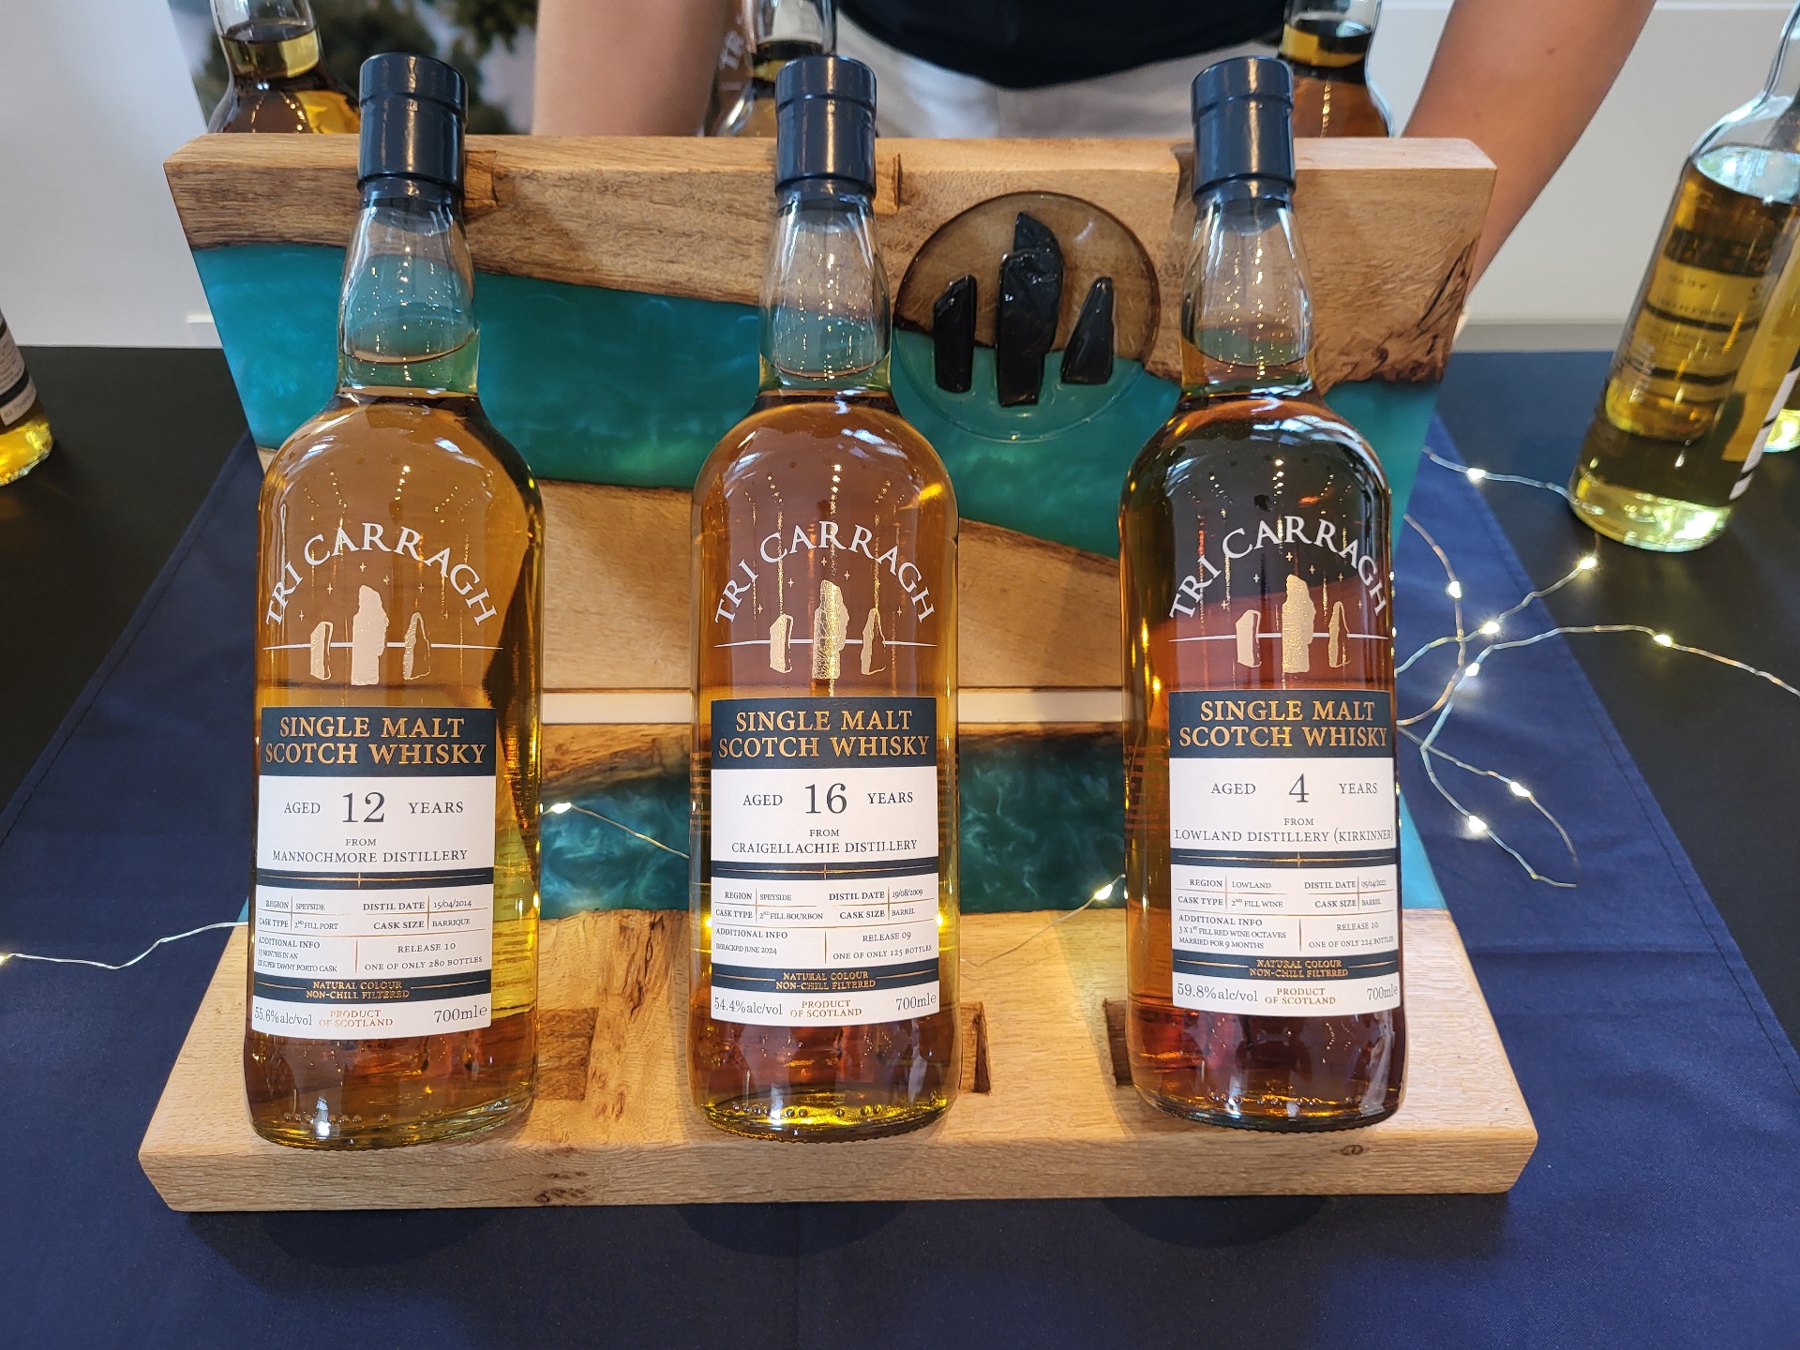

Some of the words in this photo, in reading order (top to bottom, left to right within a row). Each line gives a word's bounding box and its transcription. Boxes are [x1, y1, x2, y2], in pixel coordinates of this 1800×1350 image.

[714, 559, 759, 624] TRI
[760, 521, 935, 623] CARRAGH
[1168, 555, 1222, 619] TRI
[1222, 516, 1388, 616] CARRAGH
[266, 561, 303, 626] TRI
[304, 522, 497, 626] CARRAGH
[1200, 700, 1303, 722] SINGLE
[1312, 700, 1375, 721] MALT
[736, 710, 831, 732] SINGLE
[841, 710, 912, 731] MALT
[280, 716, 371, 738] SINGLE
[381, 717, 465, 738] MALT
[1179, 726, 1293, 747] SCOTCH
[1300, 726, 1388, 748] WHISKY
[719, 737, 820, 758] SCOTCH
[829, 735, 930, 757] WHISKY
[265, 743, 358, 764] SCOTCH
[368, 743, 487, 765] WHISKY
[1211, 783, 1256, 795] AGED
[1288, 773, 1309, 803] 4
[1338, 783, 1378, 794] YEARS
[743, 794, 783, 806] AGED
[805, 783, 847, 814] 16
[867, 791, 913, 805] YEARS
[284, 801, 321, 815] AGED
[342, 792, 385, 823] 12
[409, 801, 464, 814] YEARS
[1283, 818, 1314, 826] FROM
[809, 829, 840, 837] FROM
[1175, 829, 1242, 842] LOWLAND
[1247, 831, 1329, 843] DISTILLERY
[345, 838, 377, 847] FROM
[731, 842, 840, 854] CRAIGELLACHIE
[845, 839, 918, 853] DISTILLERY
[272, 850, 378, 864] MANNOCHMORE
[383, 850, 468, 862] DISTILLERY
[1189, 879, 1223, 887] REGION
[1232, 881, 1272, 889] LOWLAND
[1304, 881, 1333, 889] DISTIL
[1335, 880, 1356, 889] DATE
[725, 891, 753, 900] REGION
[829, 893, 859, 901] DISTIL
[861, 891, 885, 899] DATE
[266, 900, 289, 909] REGION
[295, 903, 325, 911] SPEYSIDE
[363, 903, 396, 911] DISTIL
[398, 901, 425, 910] DATE
[433, 899, 472, 909] 15/04/2014
[1178, 896, 1199, 905] CASK
[1201, 897, 1224, 906] TYPE
[1244, 900, 1260, 908] FILL
[1314, 900, 1338, 908] CASK
[1339, 900, 1357, 908] SIZE
[715, 909, 732, 917] CASK
[734, 910, 753, 919] TYPE
[839, 911, 864, 919] CASK
[866, 910, 885, 918] SIZE
[891, 908, 916, 916] BARREL
[259, 918, 271, 926] CASK
[272, 920, 288, 928] TYPE
[373, 922, 401, 930] CASK
[403, 921, 424, 929] SIZE
[432, 918, 471, 927] BARRIQUE
[1178, 915, 1236, 925] ADDITIONAL
[1238, 918, 1263, 926] INFO
[1336, 923, 1369, 931] RELEASE
[715, 928, 763, 938] ADDITIONAL
[765, 931, 788, 939] INFO
[862, 933, 900, 942] RELEASE
[902, 932, 911, 940] 09
[1251, 931, 1286, 939] OCTAVES
[259, 937, 297, 947] ADDITIONAL
[299, 940, 320, 949] INFO
[1179, 937, 1209, 945] MARRIED
[1210, 939, 1224, 947] FOR
[1224, 941, 1230, 949] 9
[1231, 941, 1264, 949] MONTHS
[397, 944, 441, 953] RELEASE
[744, 946, 760, 954] JUNE
[761, 947, 777, 955] 2024
[866, 950, 888, 958] ONLY
[890, 948, 903, 957] 125
[905, 944, 932, 955] BOTTLES
[365, 963, 384, 971] ONE
[401, 961, 426, 969] ONLY
[429, 959, 445, 967] 280
[447, 956, 483, 966] BOTTLES
[1257, 960, 1302, 968] NATURAL
[1305, 960, 1342, 969] COLOUR
[783, 972, 827, 981] NATURAL
[830, 971, 869, 980] COLOUR
[1249, 968, 1304, 978] NON-CHILL
[1307, 969, 1349, 978] FILTERED
[313, 981, 357, 990] NATURAL
[360, 981, 402, 990] COLOUR
[775, 981, 830, 990] NON-CHILL
[831, 980, 876, 989] FILTERED
[306, 990, 359, 999] NON-CHILL
[361, 990, 410, 999] FILTERED
[1276, 988, 1326, 996] PRODUCT
[802, 999, 851, 1009] PRODUCT
[1281, 997, 1336, 1005] SCOTLAND
[330, 1010, 382, 1018] PRODUCT
[790, 1010, 802, 1018] OF
[806, 1008, 862, 1018] SCOTLAND
[335, 1019, 393, 1028] SCOTLAND
